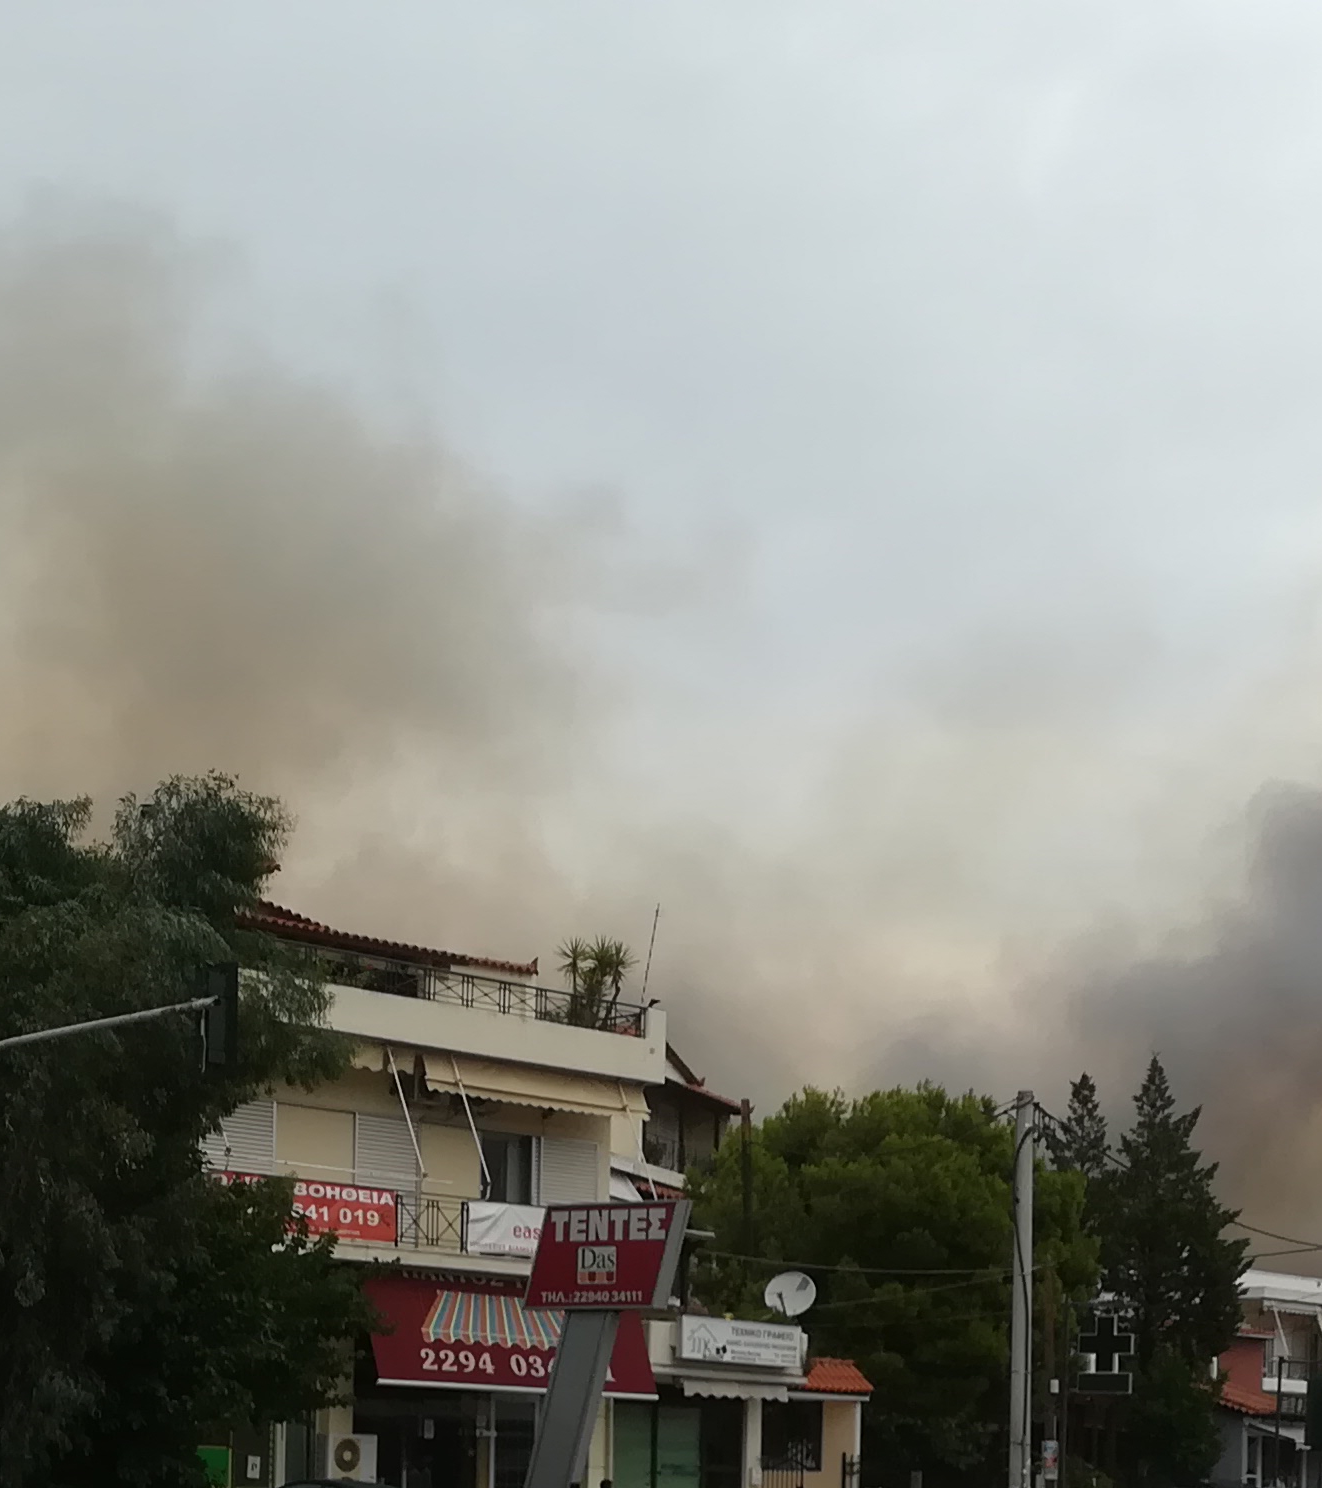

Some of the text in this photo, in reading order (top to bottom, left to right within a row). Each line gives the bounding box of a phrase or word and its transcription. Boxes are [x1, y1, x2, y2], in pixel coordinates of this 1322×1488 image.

[292, 1181, 395, 1207] ΒΟΗΘΕΙΑ
[339, 1207, 380, 1227] 019
[551, 1208, 667, 1242] ΤΕΝΤΕΣ
[580, 1247, 615, 1272] Das
[420, 1348, 495, 1374] 2294
